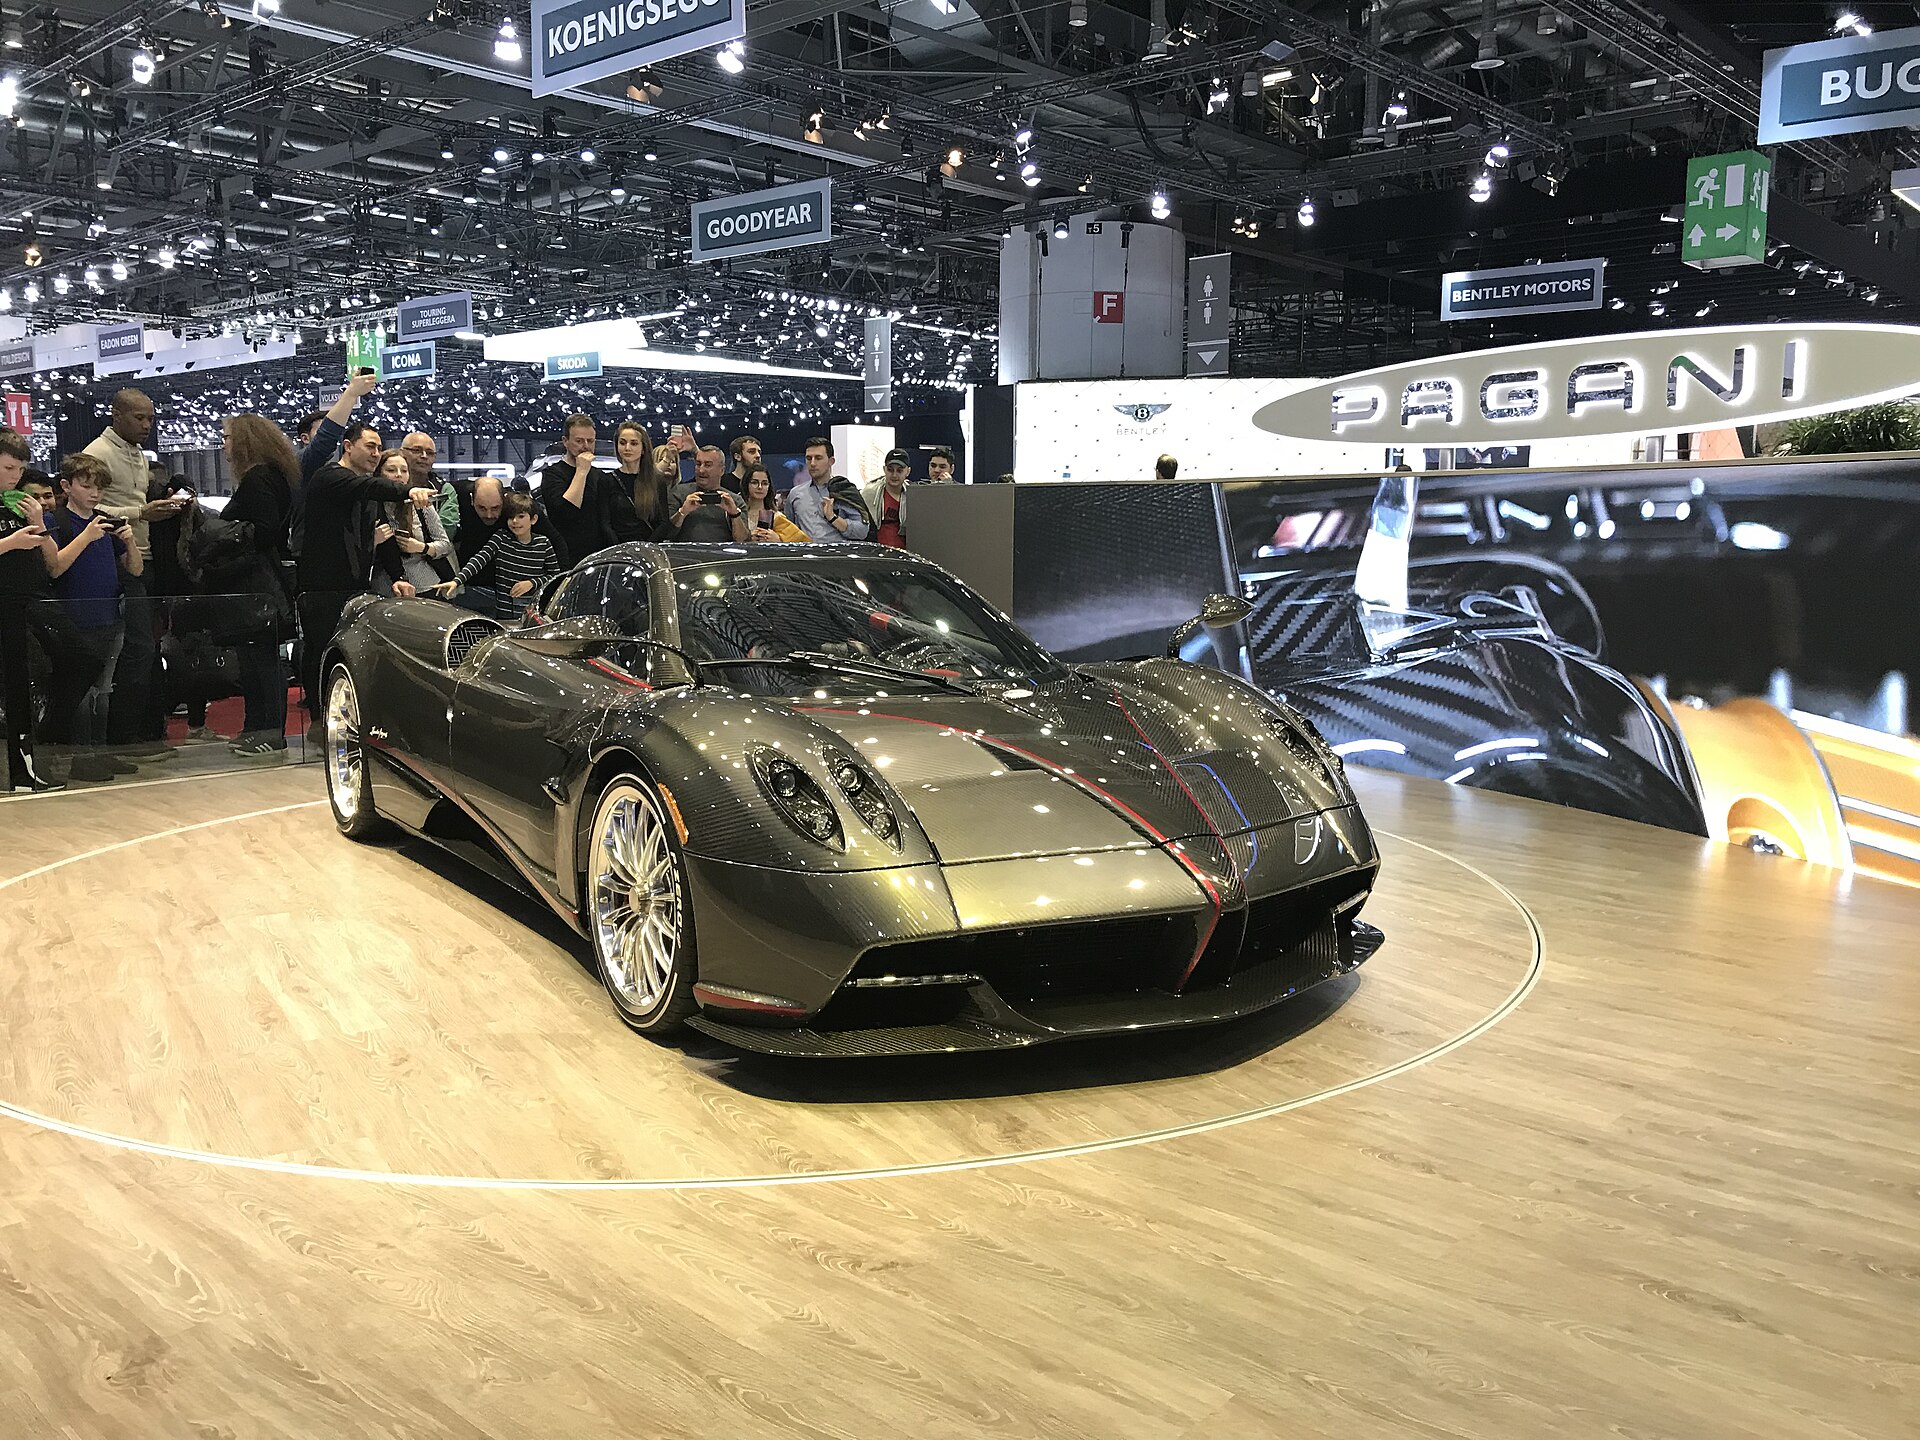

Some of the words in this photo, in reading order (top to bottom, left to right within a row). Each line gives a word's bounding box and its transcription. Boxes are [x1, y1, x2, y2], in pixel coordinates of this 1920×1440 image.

[549, 0, 719, 58] KOENIGSE
[707, 202, 812, 239] GOODYEAR
[1452, 285, 1521, 303] BENTLEY
[1524, 278, 1591, 296] MOTORS
[420, 307, 446, 318] TOURING
[1103, 295, 1117, 315] F
[411, 315, 455, 328] SUPERLEGGERA
[100, 338, 120, 350] EADON
[121, 334, 139, 347] GREEN
[391, 353, 422, 369] ICONA
[1331, 339, 1807, 433] PAGANI
[1116, 427, 1167, 436] BENTLEY
